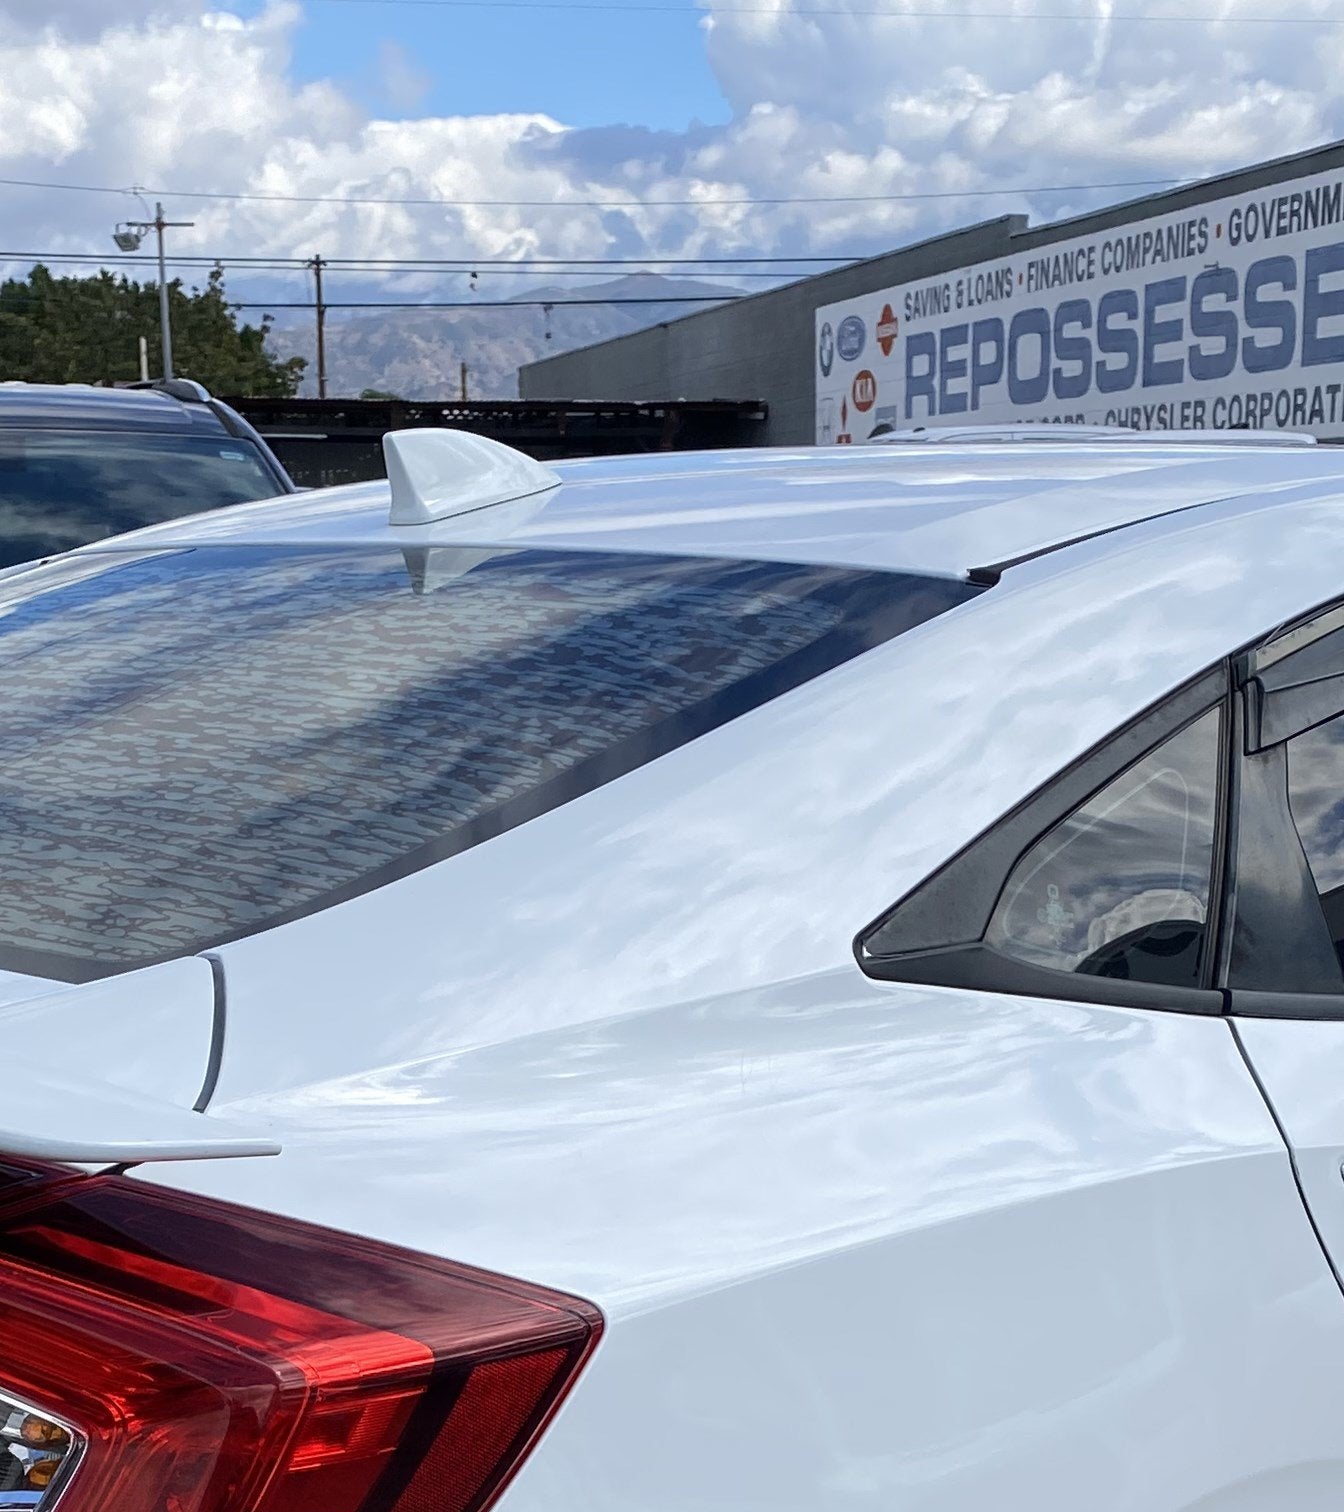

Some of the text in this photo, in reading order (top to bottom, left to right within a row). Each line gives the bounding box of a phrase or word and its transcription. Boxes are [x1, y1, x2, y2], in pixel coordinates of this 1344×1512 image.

[904, 283, 950, 322] SAVING
[967, 267, 1013, 307] LOANS
[1027, 245, 1096, 293] FINANCE
[1100, 216, 1209, 275] COMPANIES
